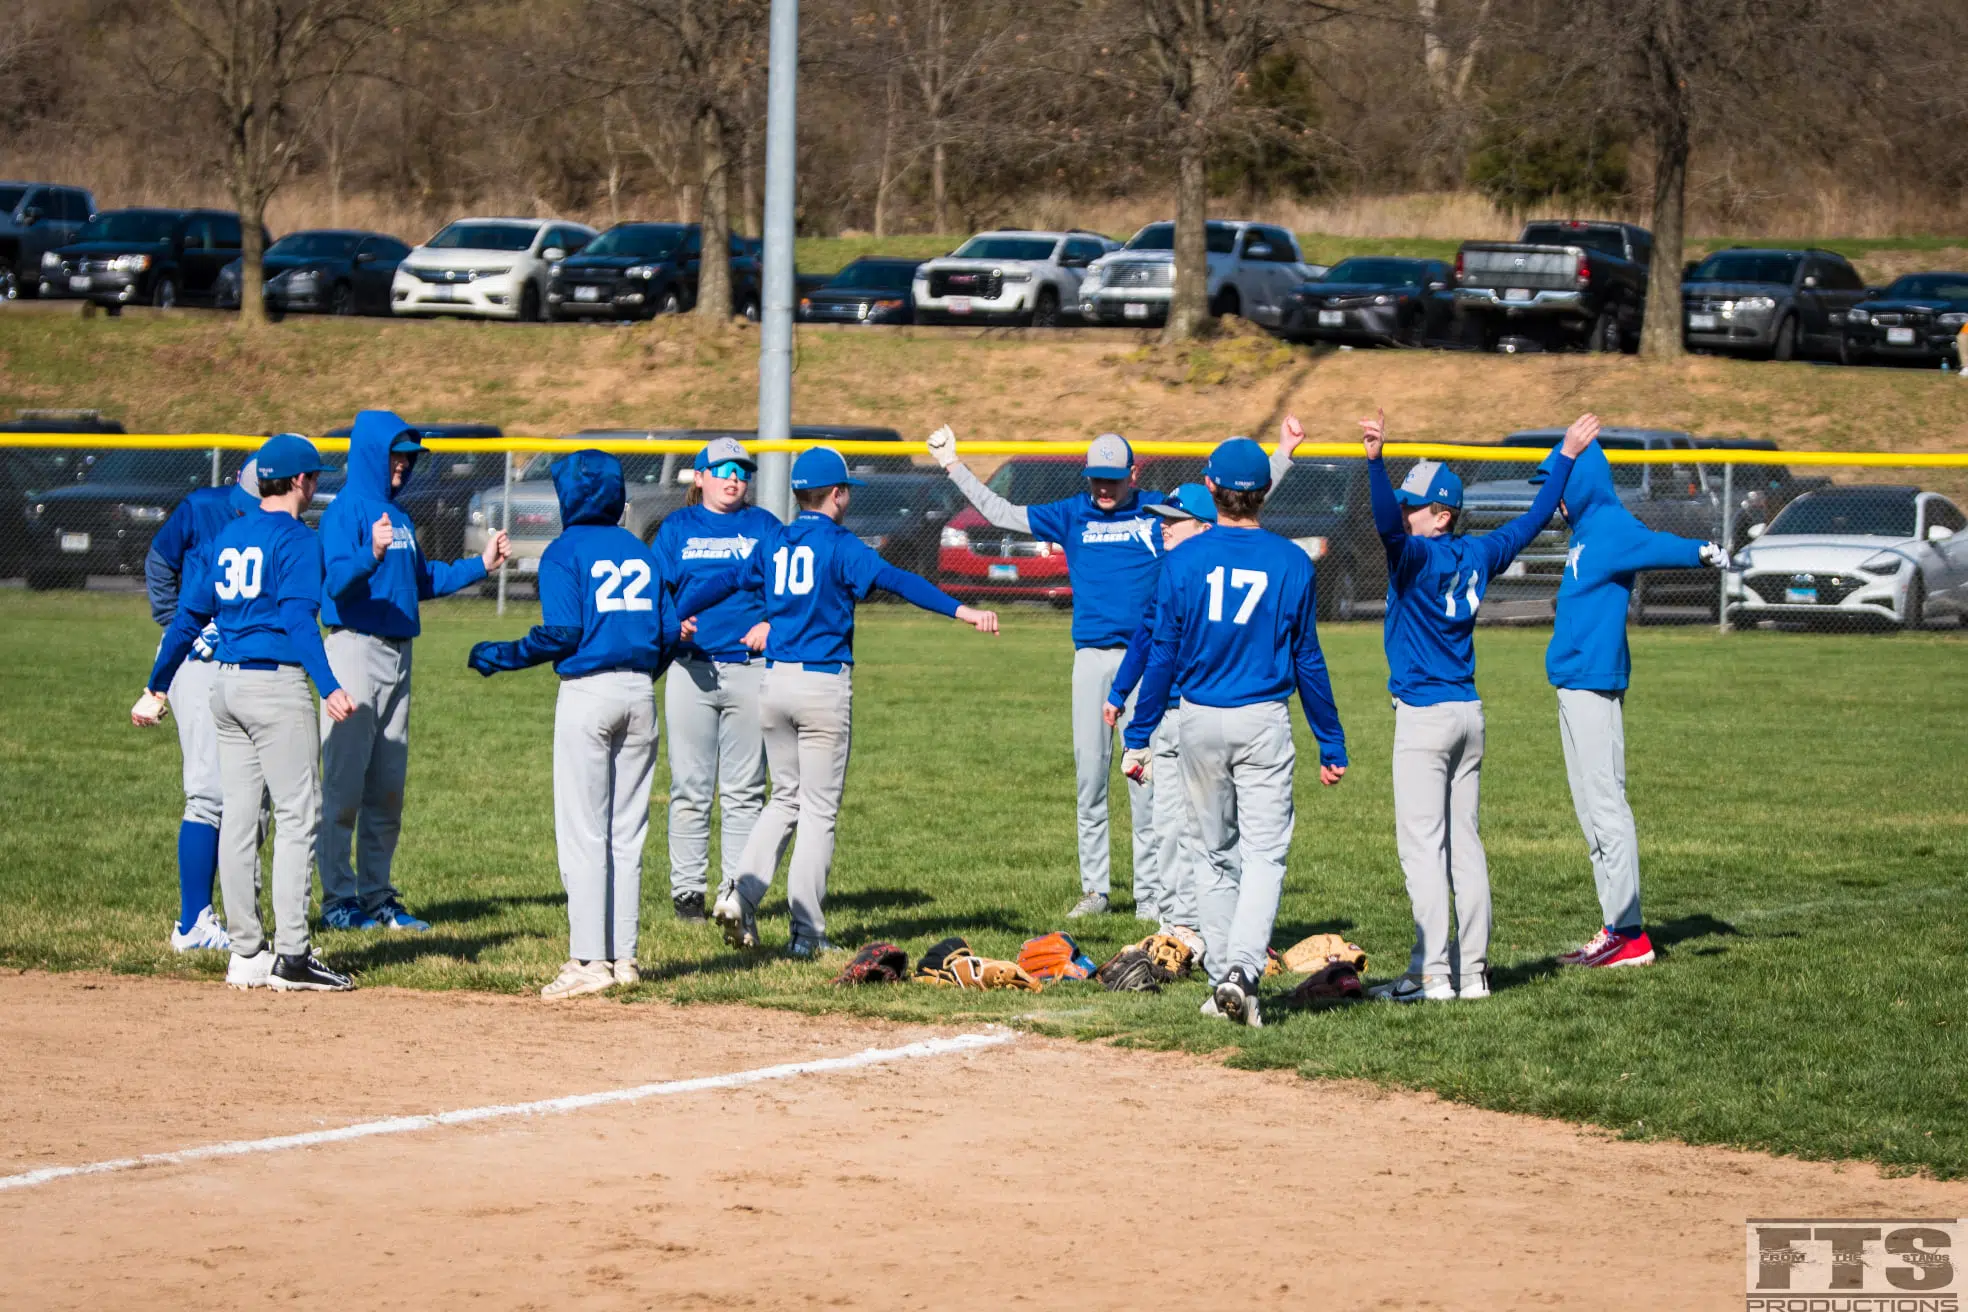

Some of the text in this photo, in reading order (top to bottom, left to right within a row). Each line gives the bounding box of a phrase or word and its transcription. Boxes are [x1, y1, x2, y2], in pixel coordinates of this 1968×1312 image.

[1438, 487, 1449, 498] 24
[681, 548, 732, 560] CHASERS
[1082, 532, 1131, 544] CHASERS
[214, 546, 264, 601] 30
[590, 558, 653, 613] 22
[772, 545, 815, 596] 10
[1206, 565, 1269, 625] 17
[1445, 569, 1480, 618] 11
